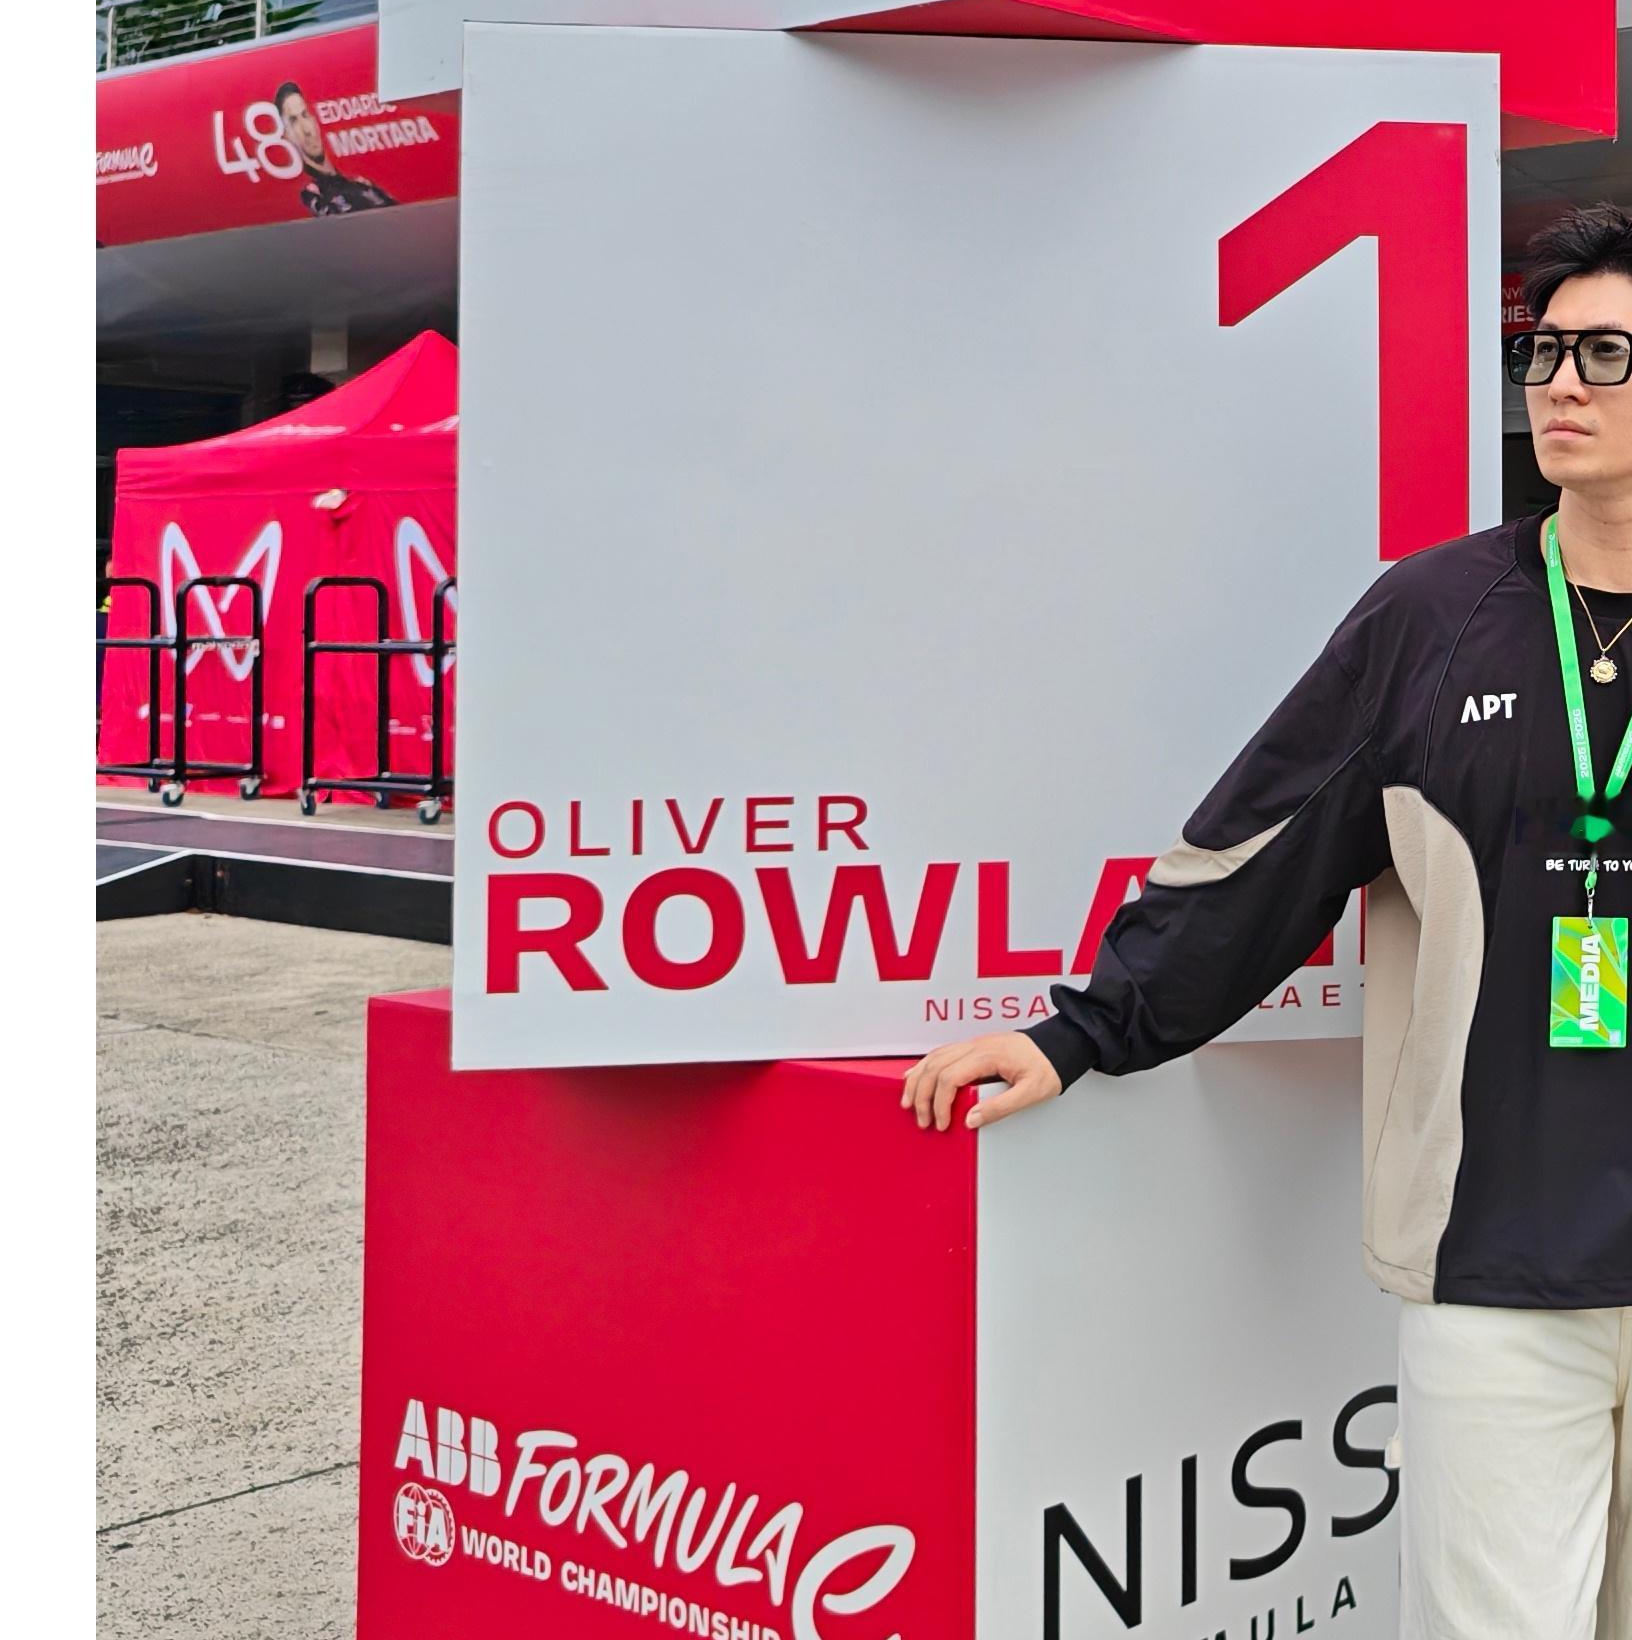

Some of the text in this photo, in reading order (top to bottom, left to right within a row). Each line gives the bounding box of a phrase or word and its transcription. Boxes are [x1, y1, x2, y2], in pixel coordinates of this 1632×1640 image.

[213, 101, 303, 184] 48
[326, 116, 440, 158] MORTARA
[1218, 121, 1471, 563] 1
[487, 795, 870, 859] OLIVER
[1545, 859, 1565, 871] BE
[1568, 859, 1599, 872] TUR
[1603, 859, 1619, 872] TO
[925, 994, 1050, 1022] NISSA
[1580, 933, 1601, 1031] MEDIA
[395, 1398, 501, 1498] ABB
[505, 1429, 804, 1607] FORMULA
[461, 1525, 553, 1582] WORLD
